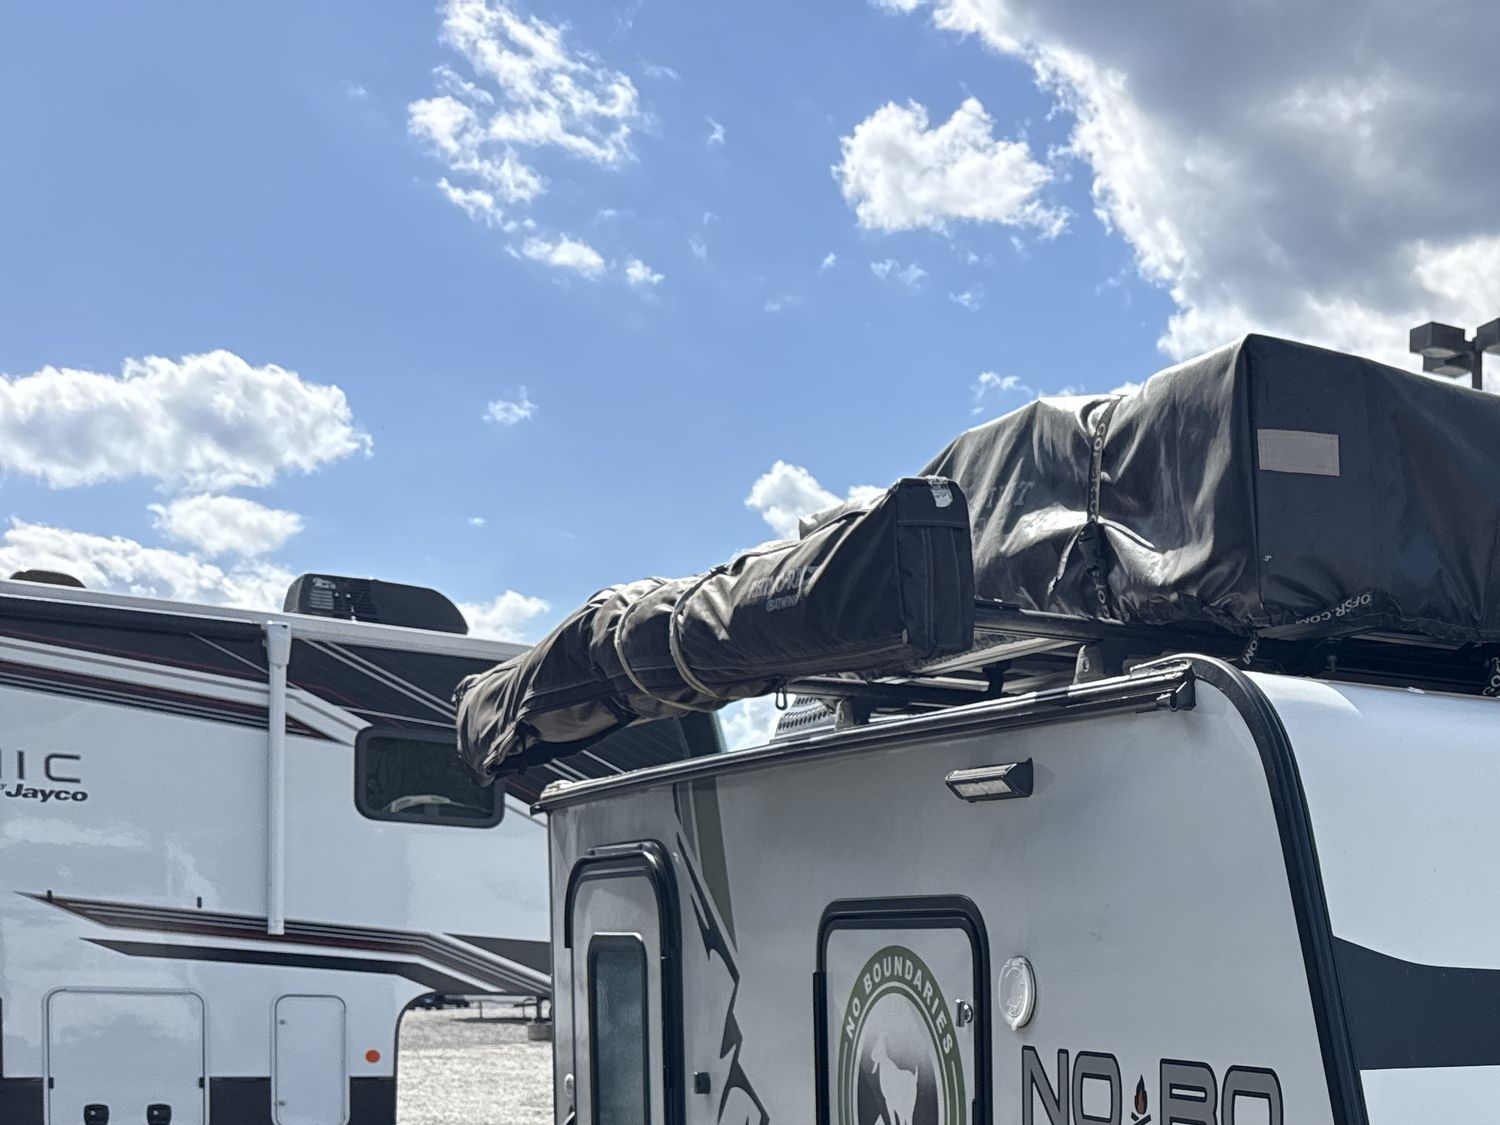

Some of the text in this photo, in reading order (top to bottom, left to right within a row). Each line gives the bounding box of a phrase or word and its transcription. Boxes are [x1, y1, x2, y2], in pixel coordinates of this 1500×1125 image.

[0, 749, 81, 784] IC
[5, 783, 88, 803] Jayco
[846, 956, 953, 1054] NO BOUNDARIES
